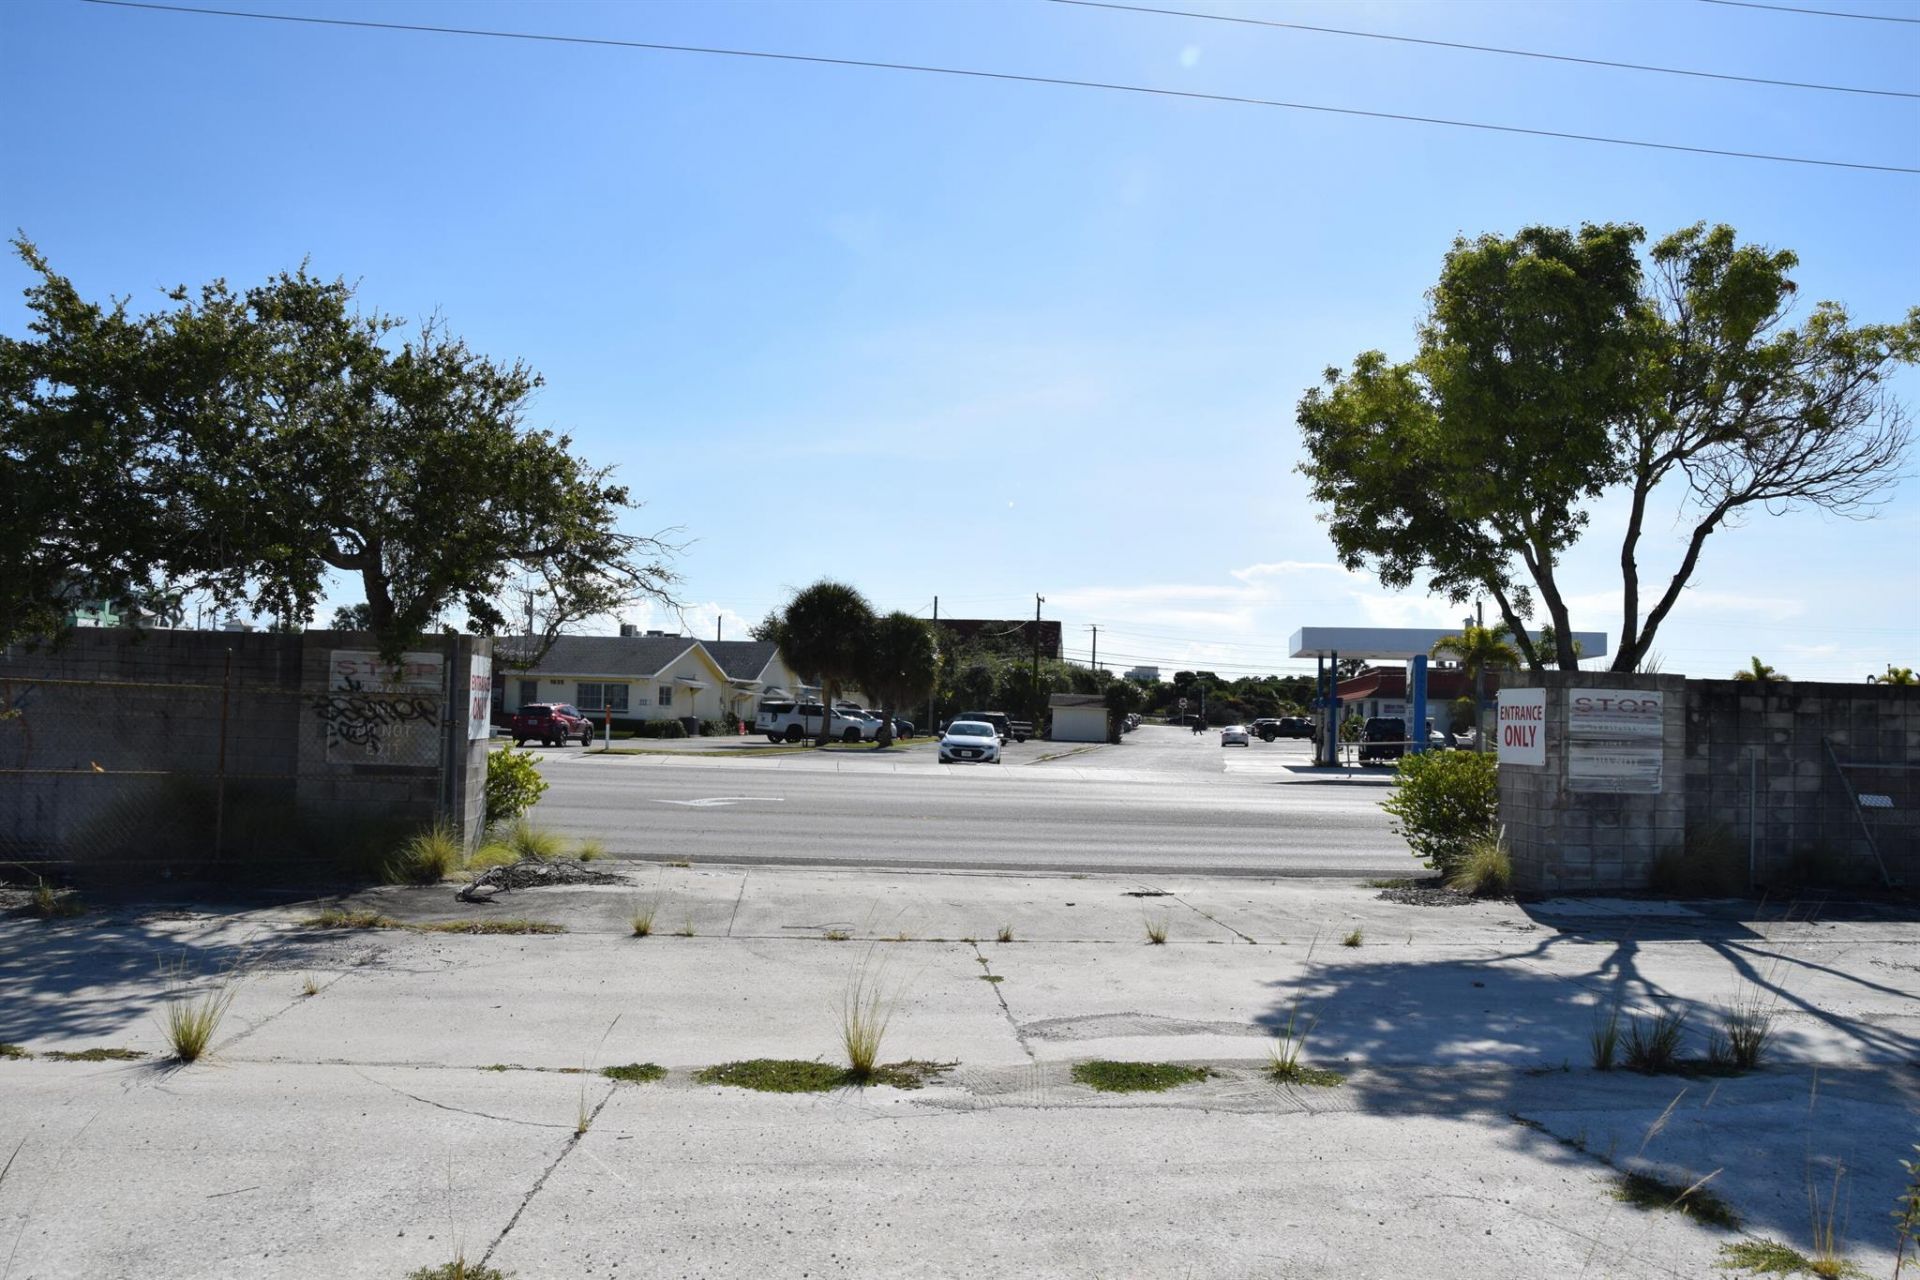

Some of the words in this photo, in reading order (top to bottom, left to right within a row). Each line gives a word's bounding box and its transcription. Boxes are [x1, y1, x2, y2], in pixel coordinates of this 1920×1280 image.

[336, 660, 437, 678] STP
[1500, 705, 1542, 721] ENTRANCE
[1573, 697, 1659, 714] STOP
[381, 724, 412, 738] NOT
[1504, 725, 1537, 748] ONLY
[365, 743, 401, 756] EXIT
